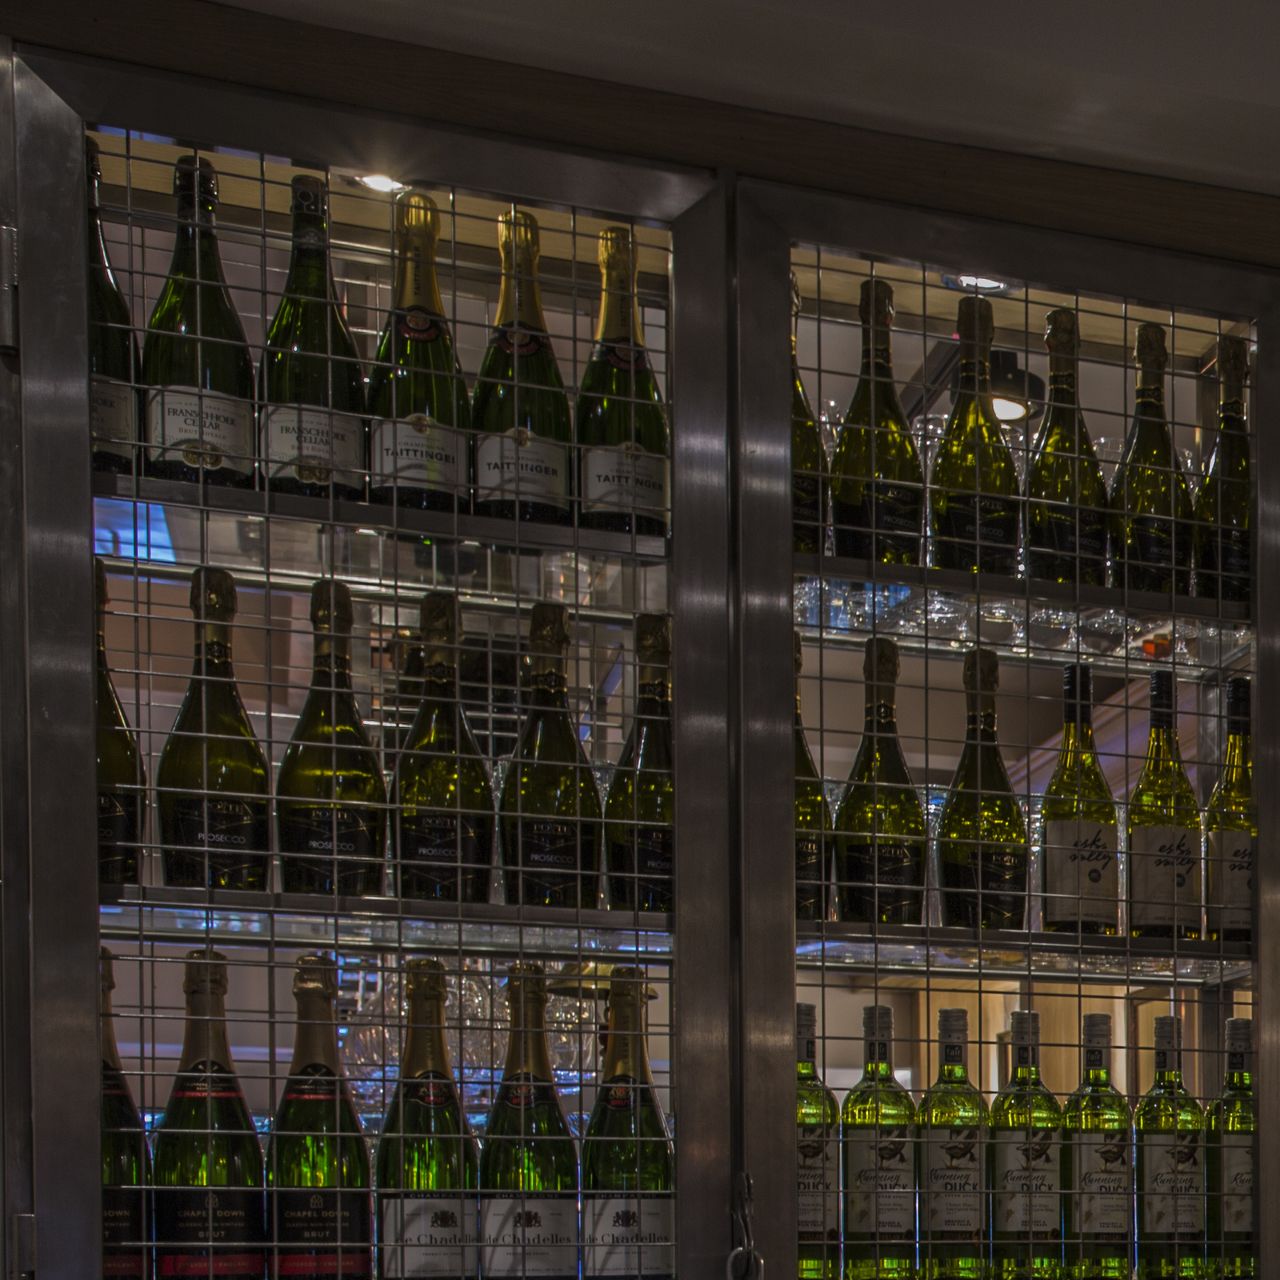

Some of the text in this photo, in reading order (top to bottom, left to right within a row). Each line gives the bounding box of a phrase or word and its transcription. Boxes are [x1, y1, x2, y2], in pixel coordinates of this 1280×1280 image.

[595, 473, 664, 492] TAITTNGER
[530, 853, 575, 864] PROSECCO
[944, 1182, 978, 1191] DUCK
[177, 1209, 246, 1219] CHAPE DOWN
[284, 1209, 319, 1218] CHAPEL
[303, 1231, 331, 1240] BRUT
